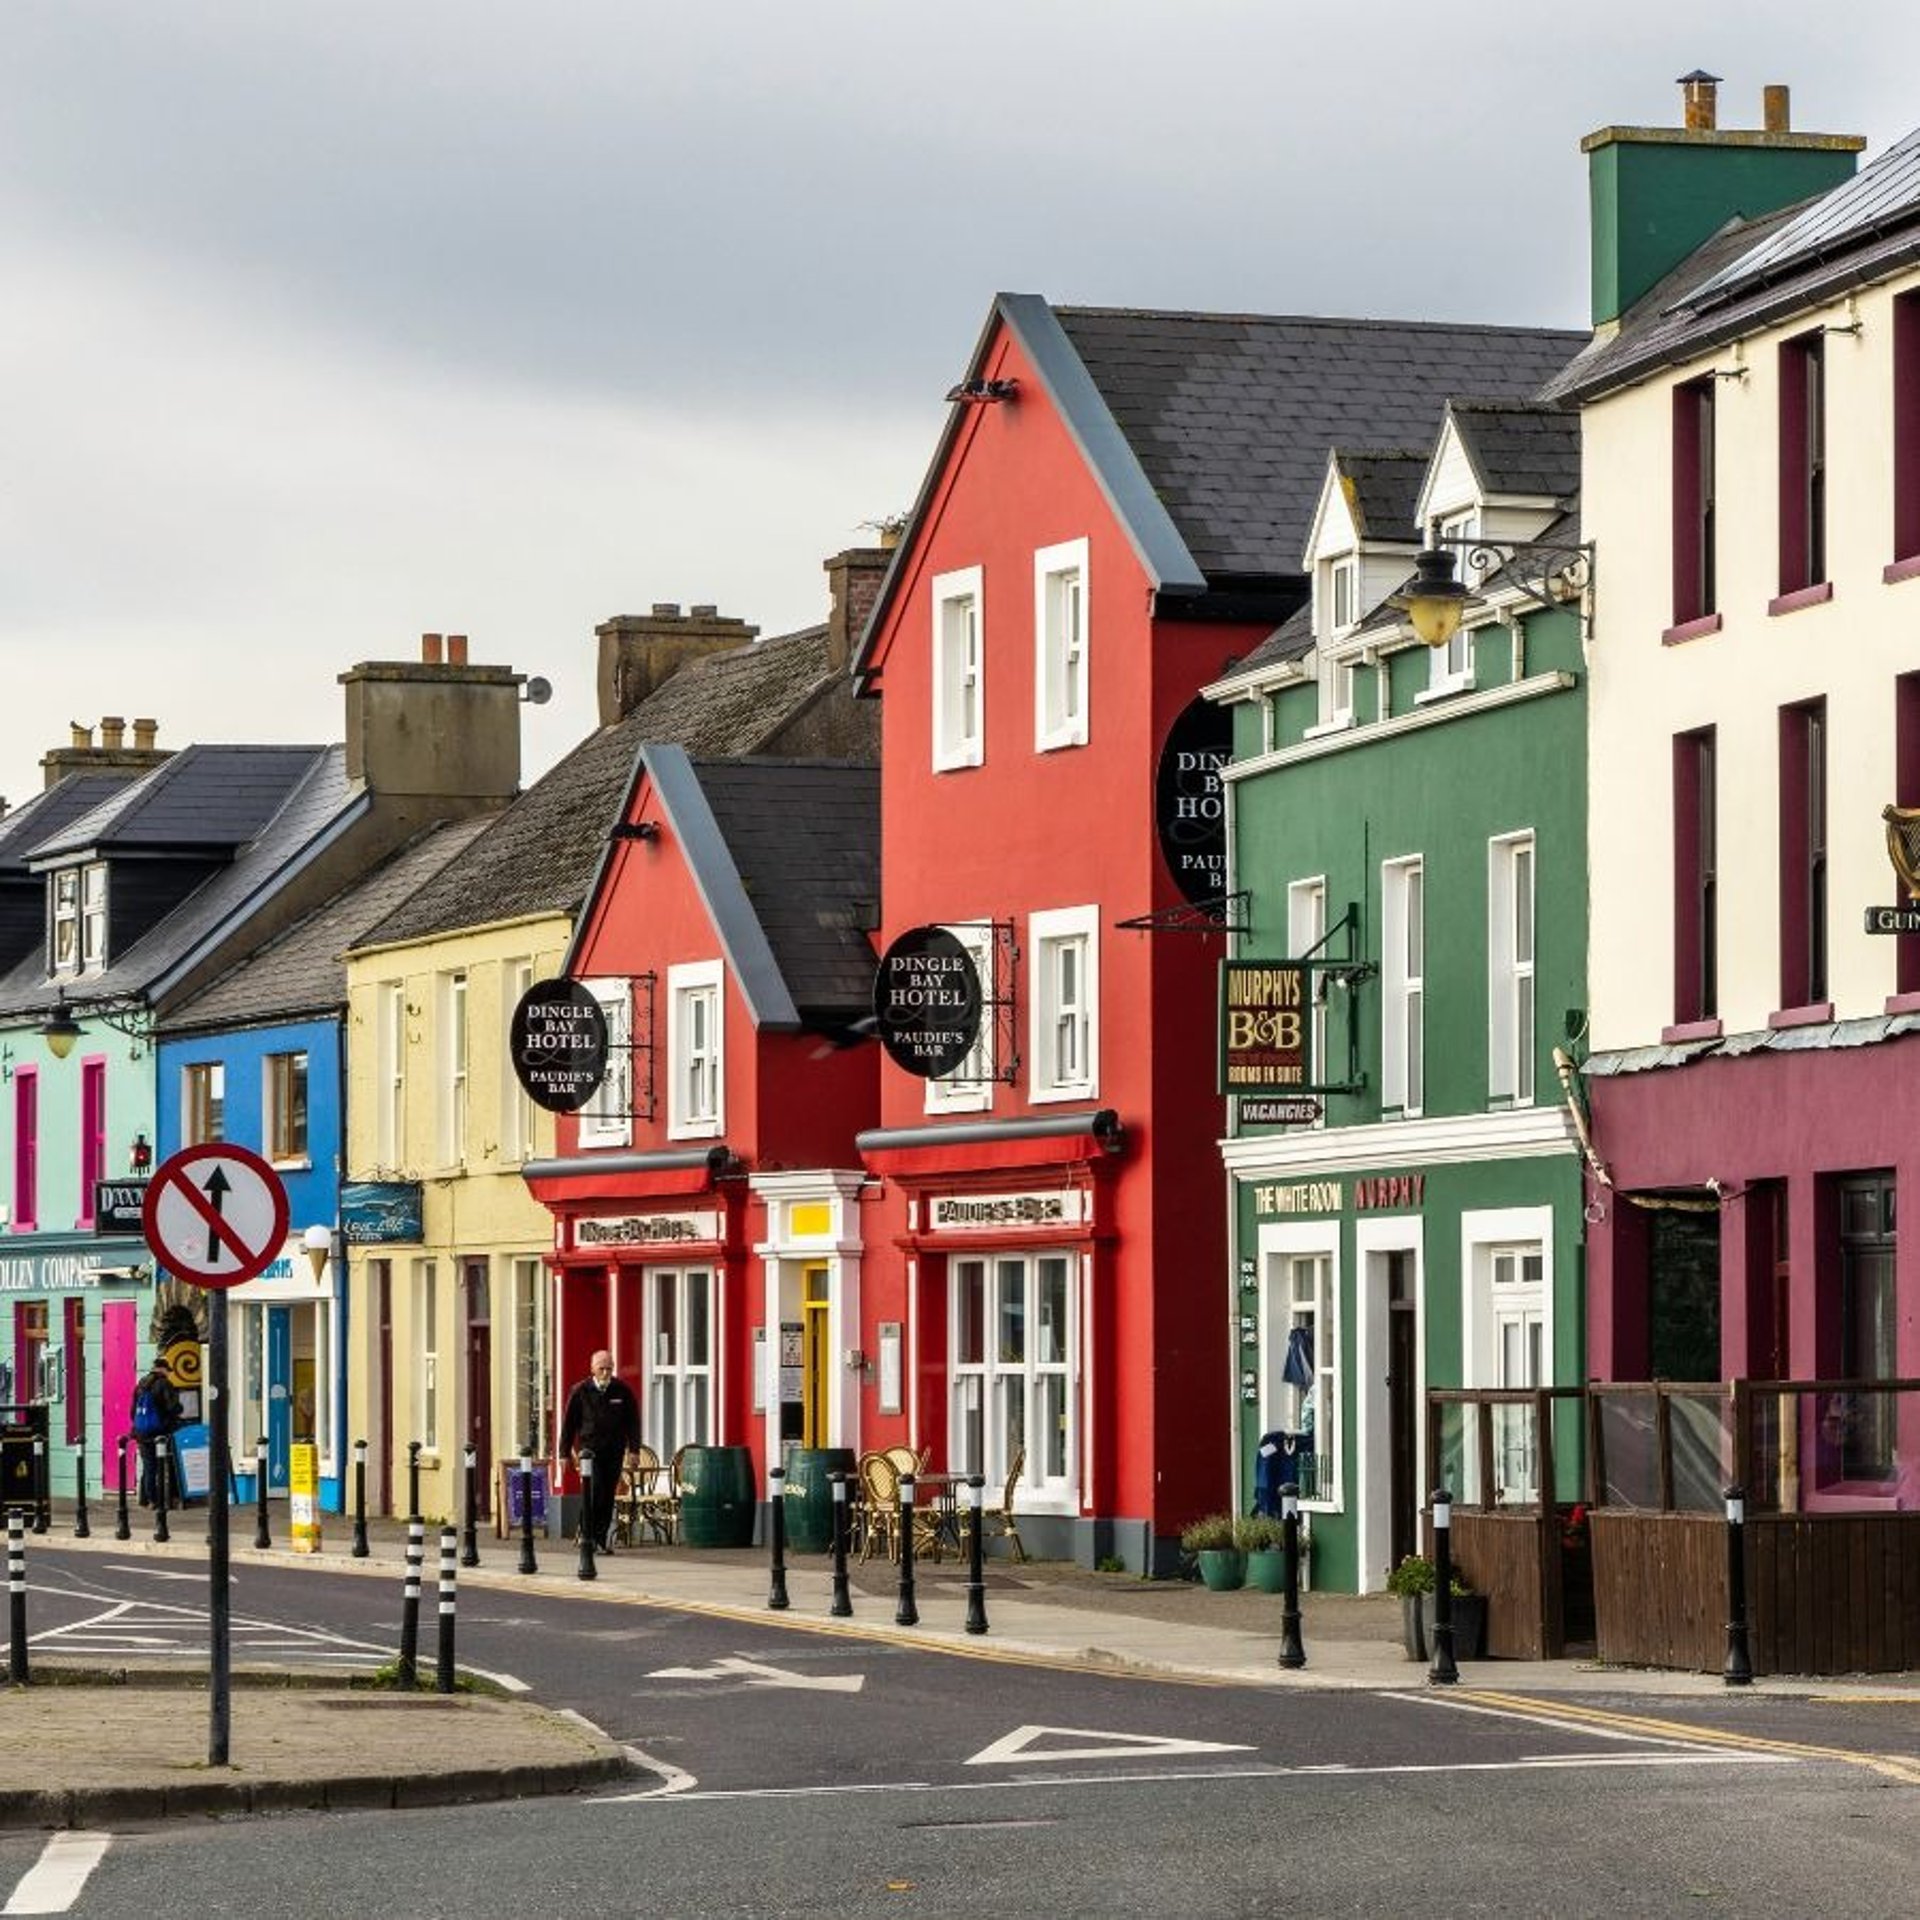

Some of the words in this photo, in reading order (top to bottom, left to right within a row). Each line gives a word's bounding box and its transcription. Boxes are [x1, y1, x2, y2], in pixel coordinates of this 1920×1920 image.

[1177, 752, 1233, 771] DIN
[1182, 855, 1227, 870] PAU
[891, 957, 964, 972] DINGLE
[910, 974, 945, 986] BAY
[1228, 970, 1300, 1006] MURPHYS
[890, 990, 966, 1006] HOTEL
[527, 1005, 595, 1019] DINGLE
[545, 1021, 577, 1033] BAY
[1228, 1011, 1300, 1049] B&B
[526, 1034, 596, 1049] HOTEL
[893, 1031, 964, 1044] PAUDIE'S
[914, 1044, 944, 1056] BAR
[530, 1071, 594, 1083] PAUDIE'S
[549, 1083, 577, 1094] BAR
[1243, 1104, 1315, 1120] VACANCIES
[1254, 1186, 1275, 1214] THE
[1275, 1184, 1308, 1212] WHITE
